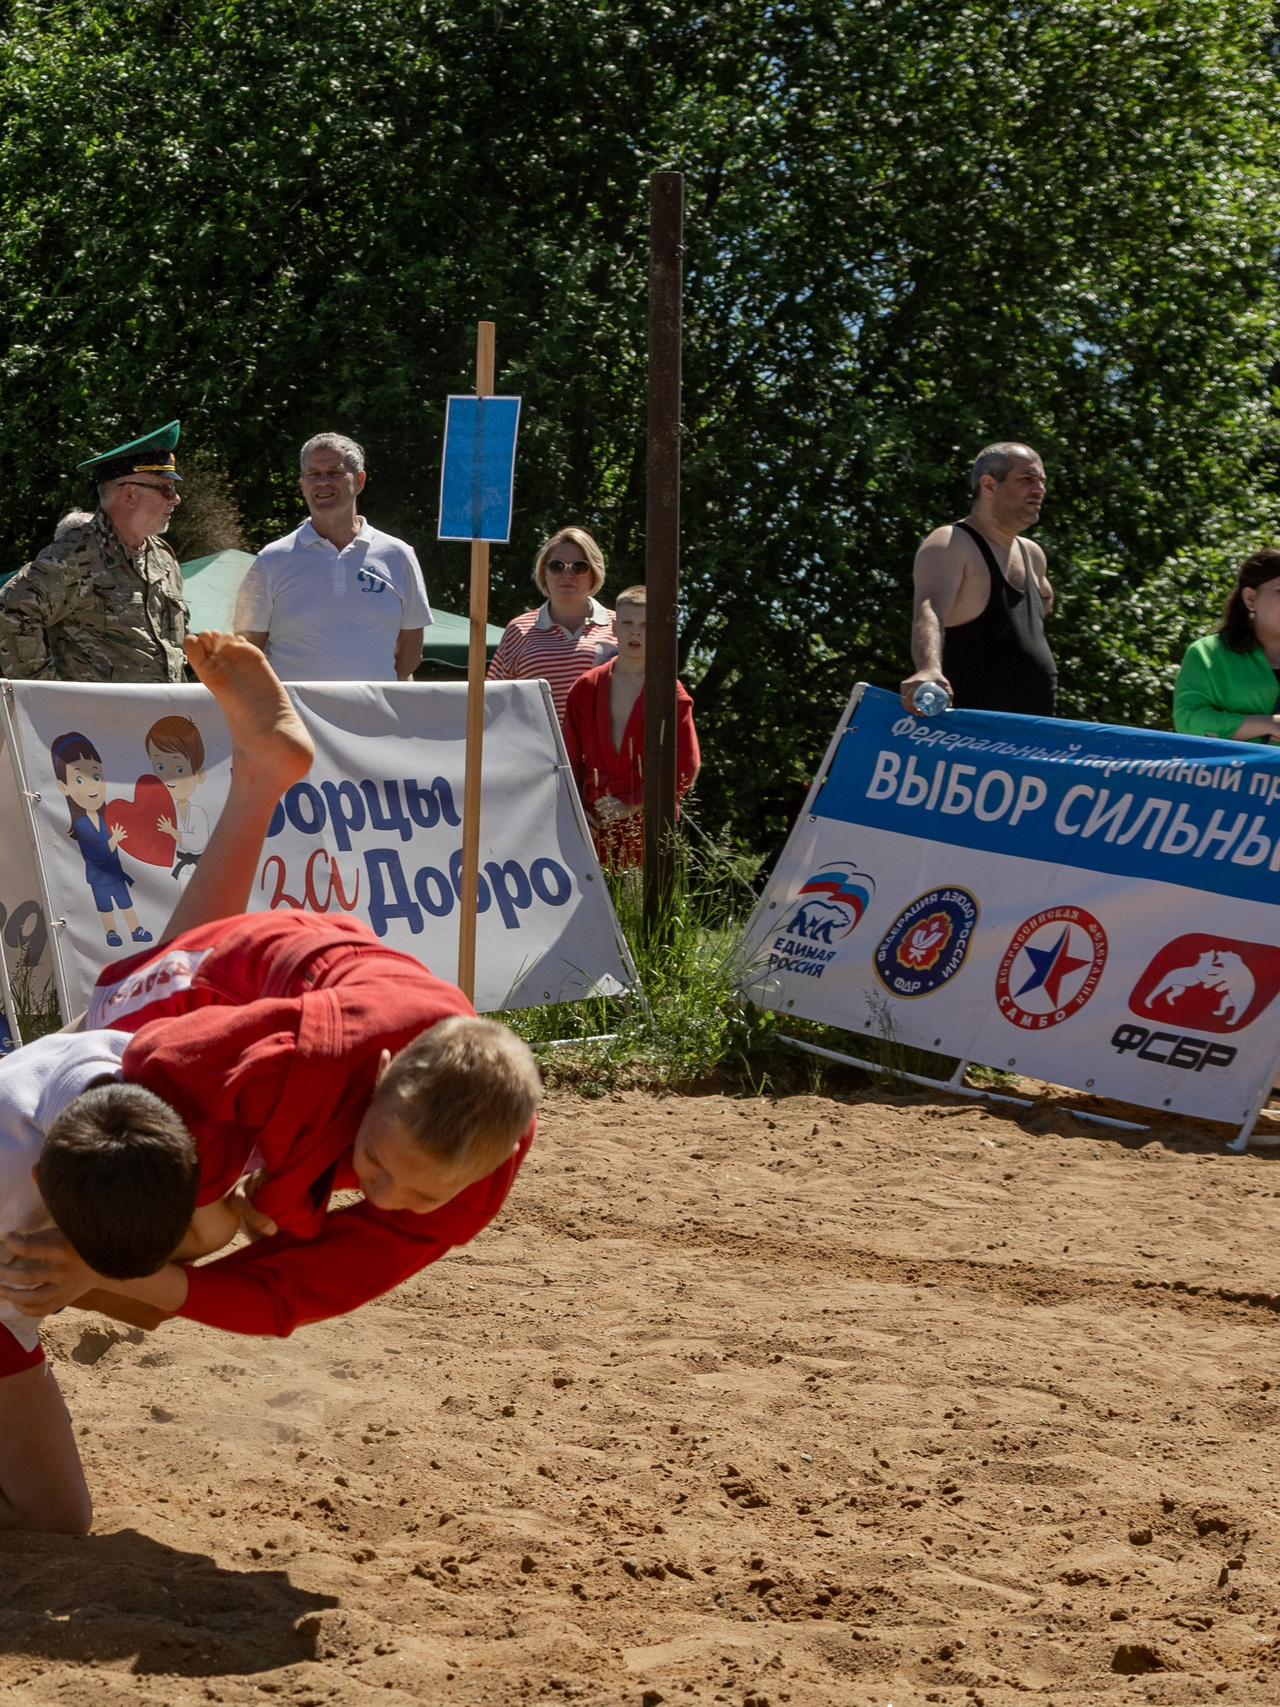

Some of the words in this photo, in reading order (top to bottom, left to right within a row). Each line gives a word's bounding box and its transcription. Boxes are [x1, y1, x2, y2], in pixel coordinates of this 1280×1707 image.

[891, 715, 1082, 763] Федеральный
[1073, 753, 1246, 792] партийный
[231, 767, 462, 852] орцы
[866, 750, 1048, 826] ВЫБОР
[261, 848, 360, 914] за
[363, 847, 572, 938] Добро
[941, 891, 975, 918] ДЗЮДО
[773, 937, 837, 962] ЕДИНАЯ
[878, 893, 939, 961] ФЕДЕРАЦИЯ
[942, 921, 973, 978] РОССИИ
[769, 953, 826, 979] РОССИЯ
[894, 977, 921, 992] ФДР
[999, 996, 1066, 1027] САМБО
[1111, 1023, 1238, 1073] ФСБР
